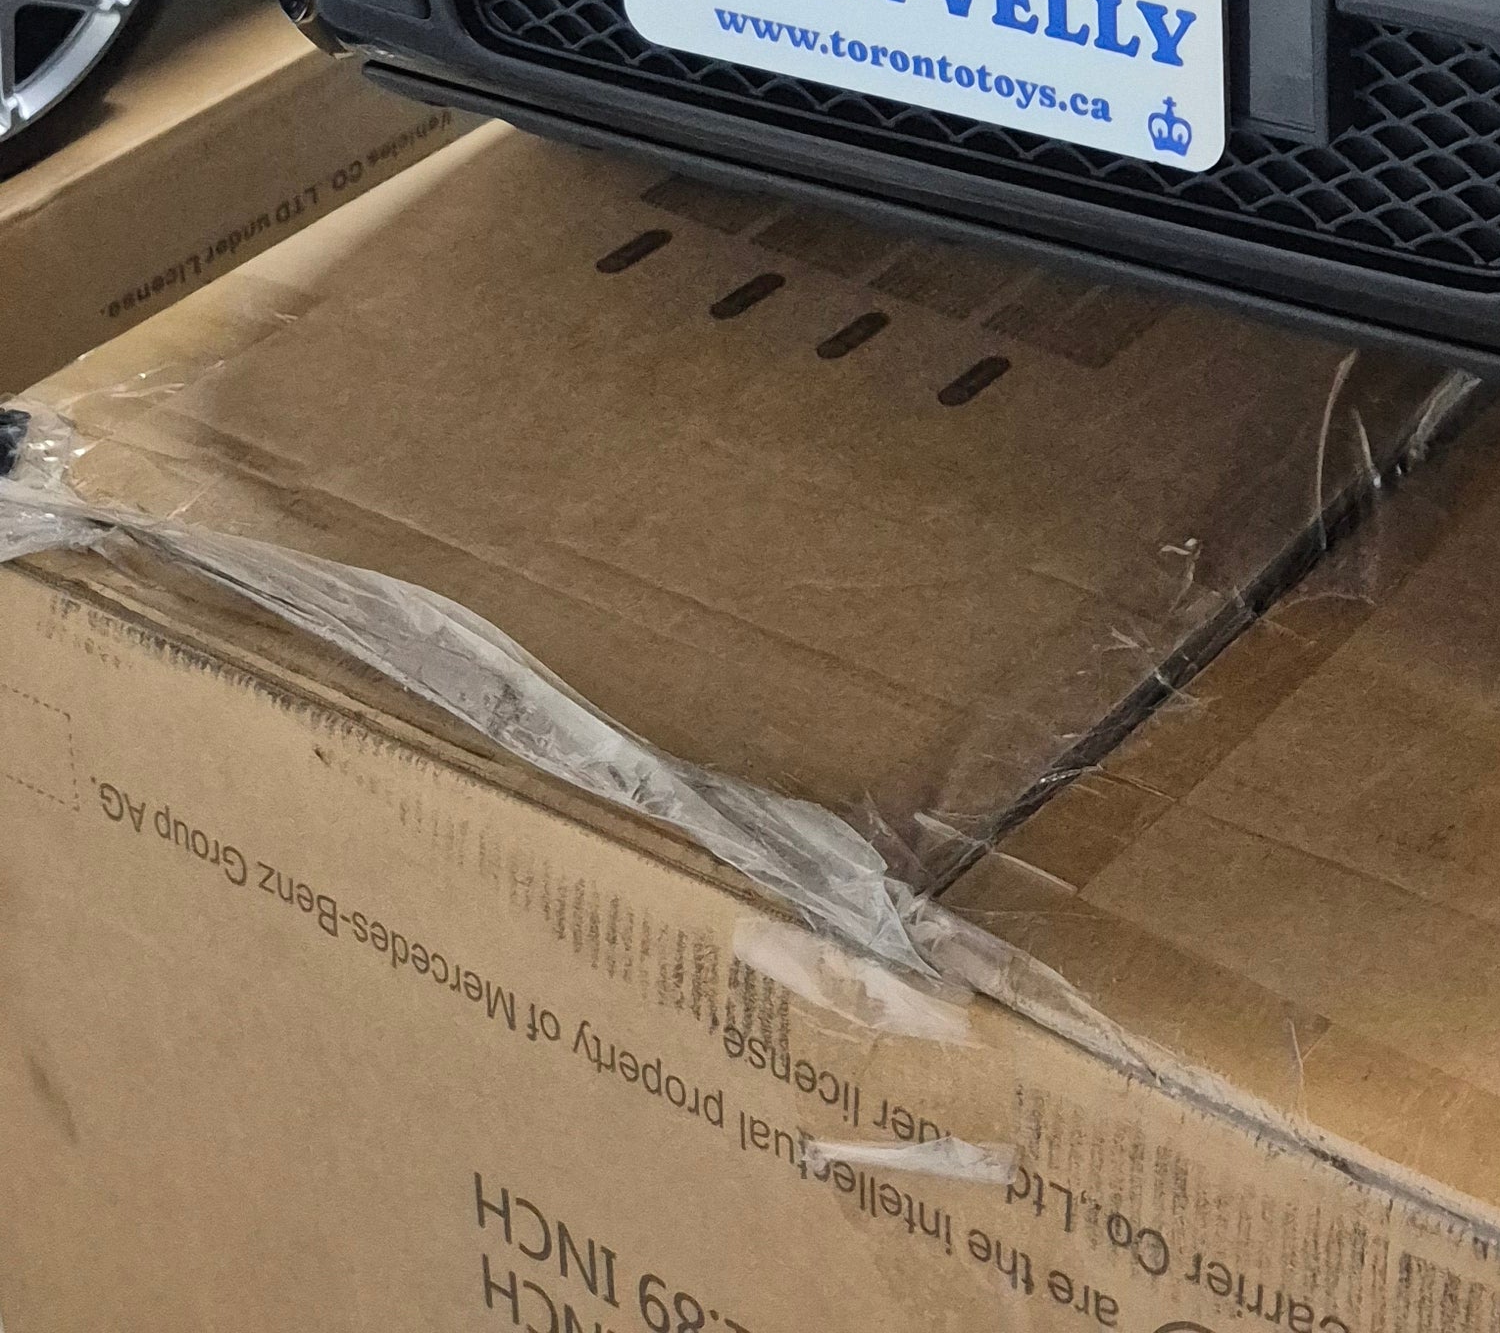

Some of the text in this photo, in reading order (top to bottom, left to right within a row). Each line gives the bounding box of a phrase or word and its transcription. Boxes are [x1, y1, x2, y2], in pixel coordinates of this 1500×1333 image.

[714, 7, 1113, 124] www.torontotoys.ca
[205, 212, 272, 262] under
[154, 805, 248, 887] Group
[257, 861, 516, 1031] Mercedes-Benz
[526, 1003, 561, 1041] of
[573, 1019, 724, 1128] property
[474, 1172, 751, 1333] .89 INCH
[967, 1229, 1034, 1296] the
[1047, 1269, 1119, 1327] are
